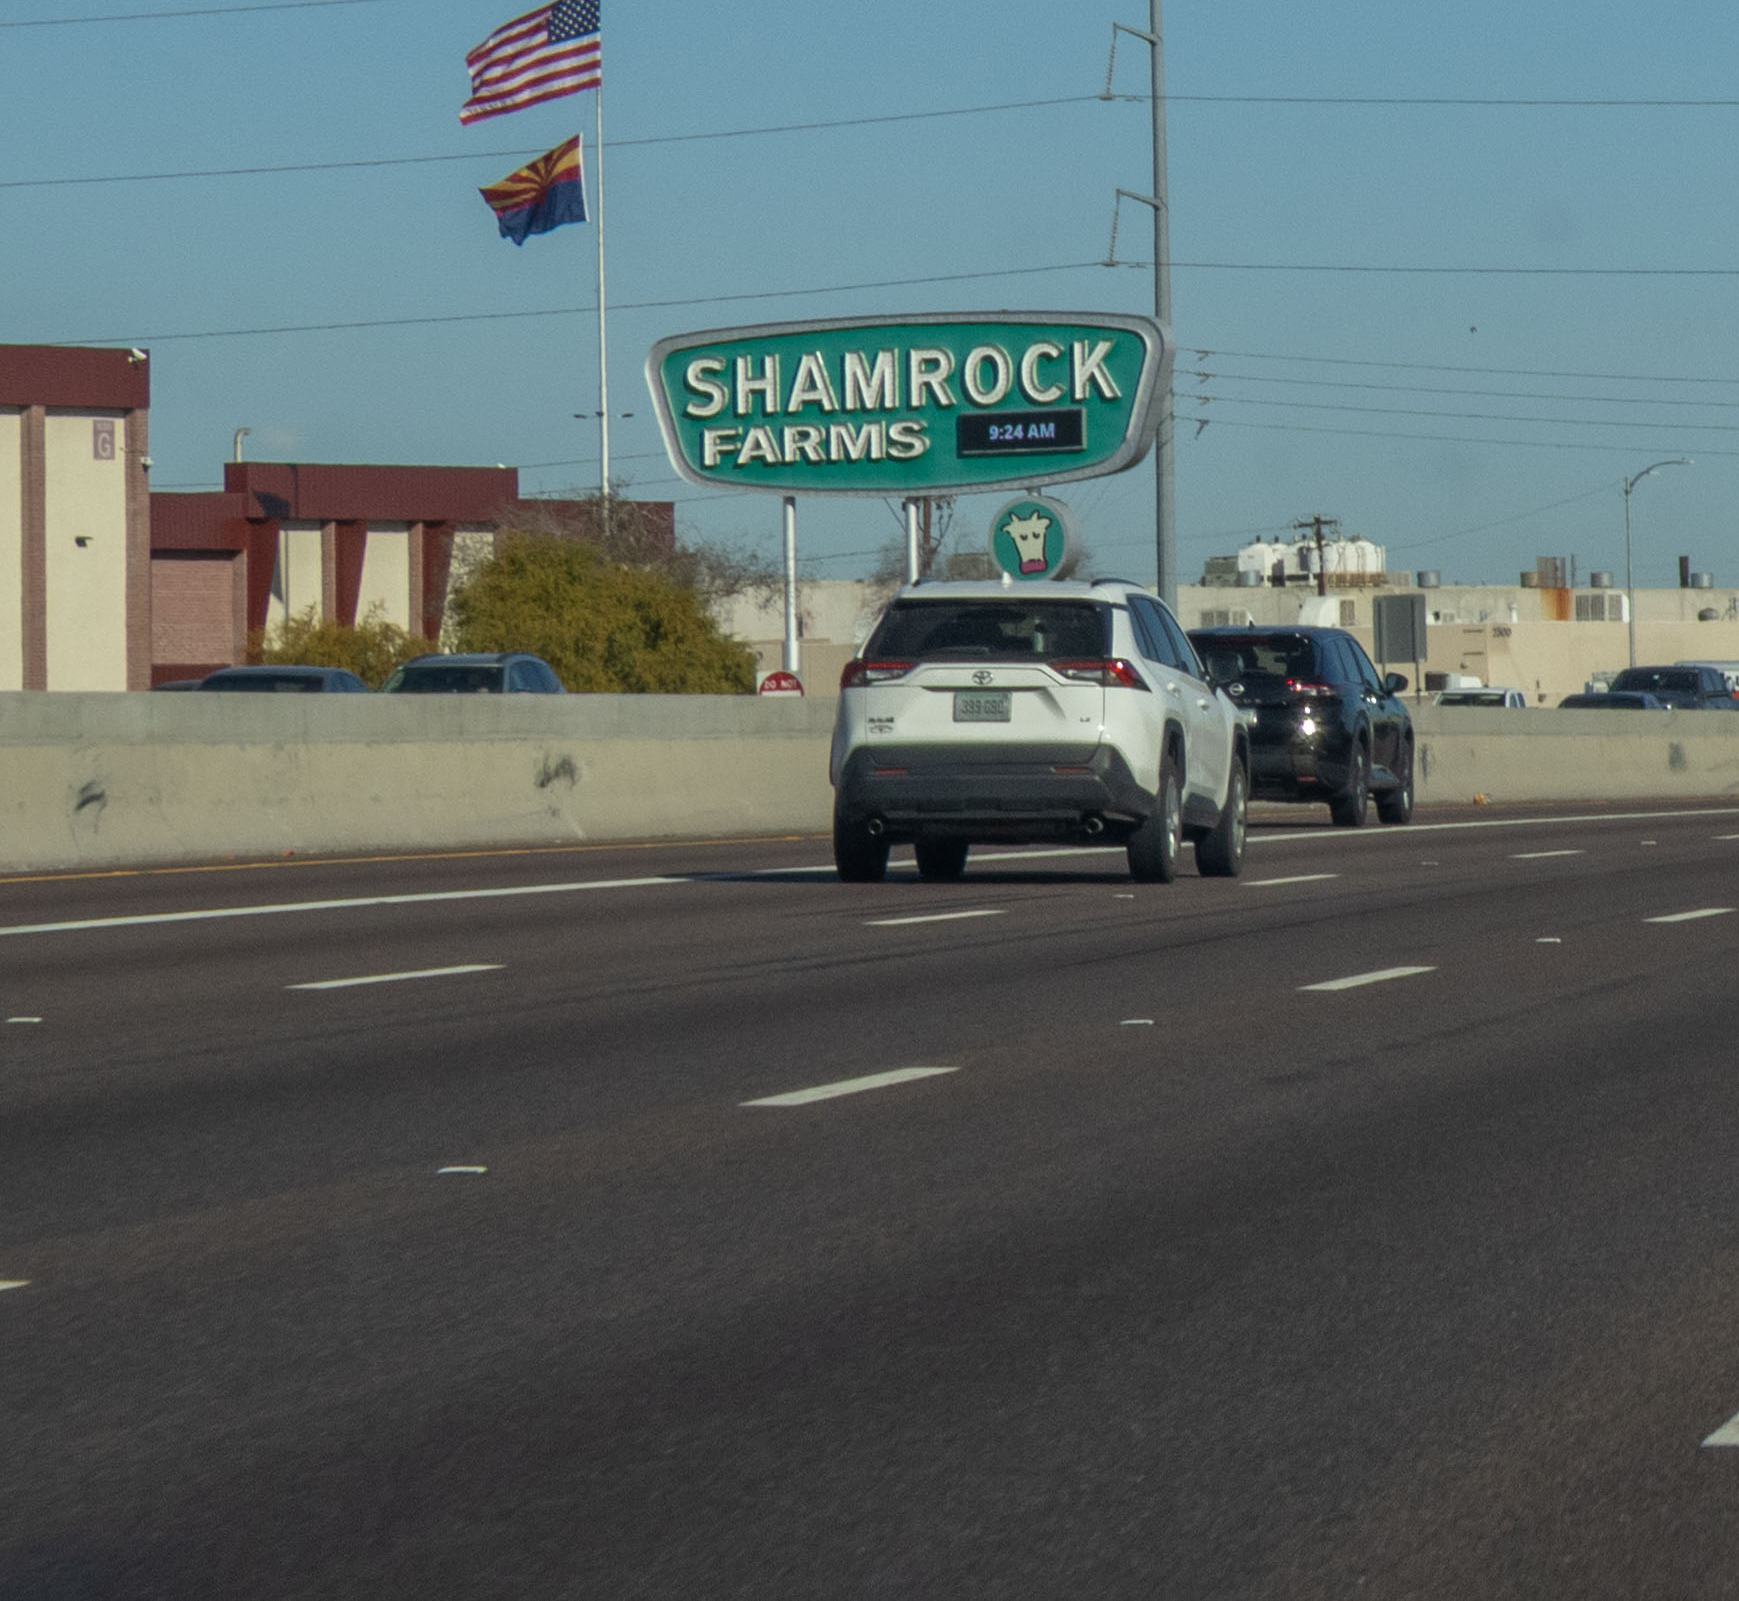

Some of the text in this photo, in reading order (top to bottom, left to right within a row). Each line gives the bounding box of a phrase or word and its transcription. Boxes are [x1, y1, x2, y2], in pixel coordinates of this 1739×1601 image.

[683, 338, 1122, 418] SHAMROCK
[702, 419, 931, 467] FARMS
[988, 422, 1057, 440] 9:24 AM
[98, 432, 111, 458] G
[764, 678, 797, 689] DO NOT
